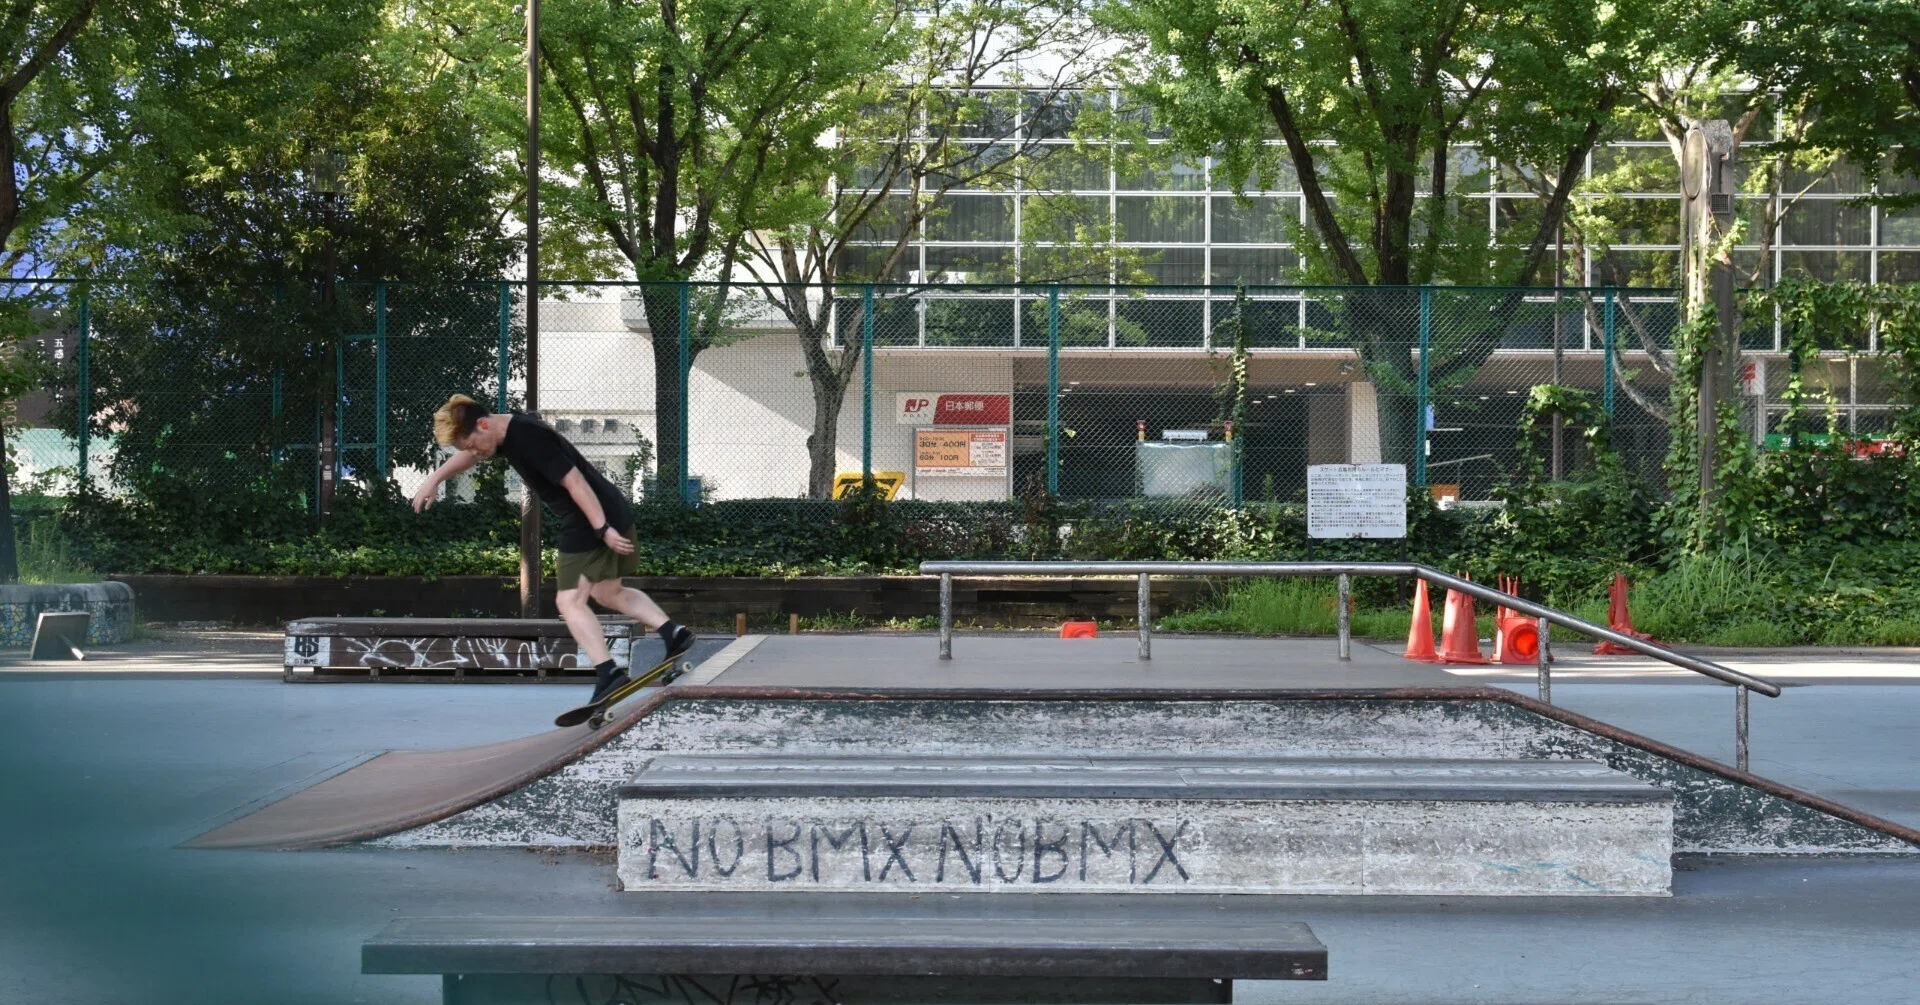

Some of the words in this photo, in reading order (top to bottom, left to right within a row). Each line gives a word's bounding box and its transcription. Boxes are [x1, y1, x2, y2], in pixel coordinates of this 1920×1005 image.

[904, 398, 929, 412] JP
[945, 400, 984, 411] 日本郵便
[648, 815, 745, 880] NO
[766, 814, 917, 883] BMX
